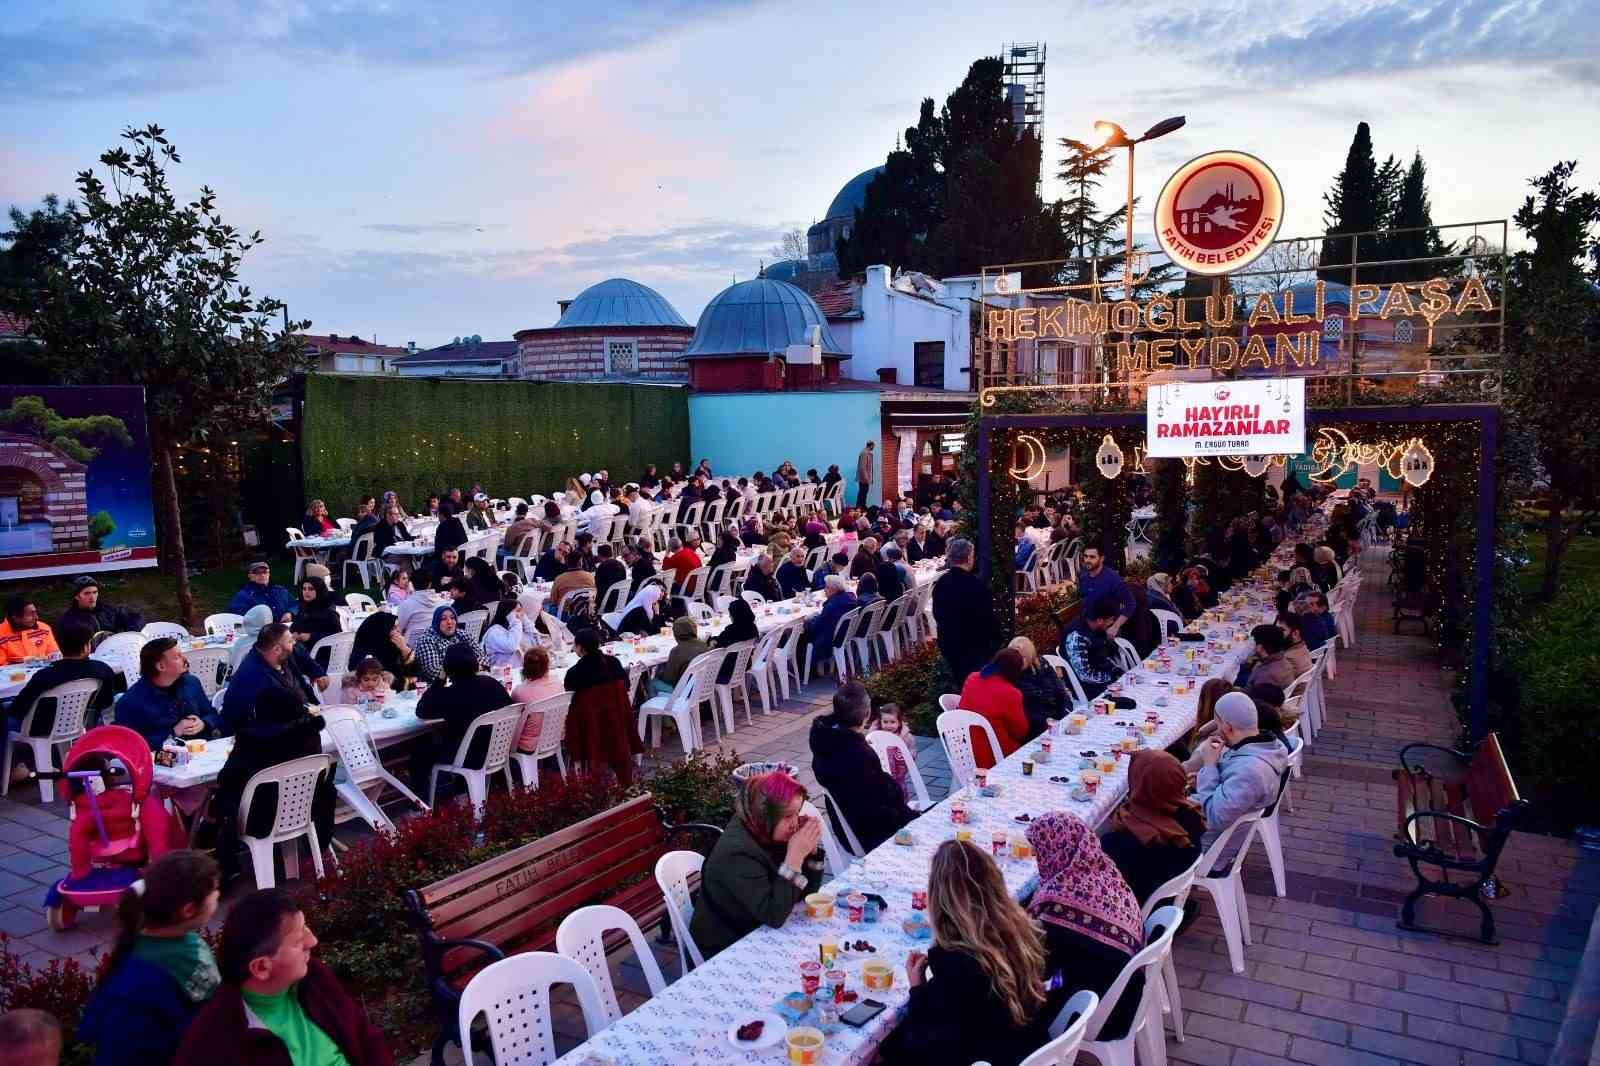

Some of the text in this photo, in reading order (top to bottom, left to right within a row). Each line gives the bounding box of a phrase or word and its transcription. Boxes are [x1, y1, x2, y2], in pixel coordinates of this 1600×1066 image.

[1116, 330, 1320, 370] MEYDANI
[1185, 404, 1260, 422] HAYIRLI
[1157, 419, 1290, 438] RAMAZANLAR
